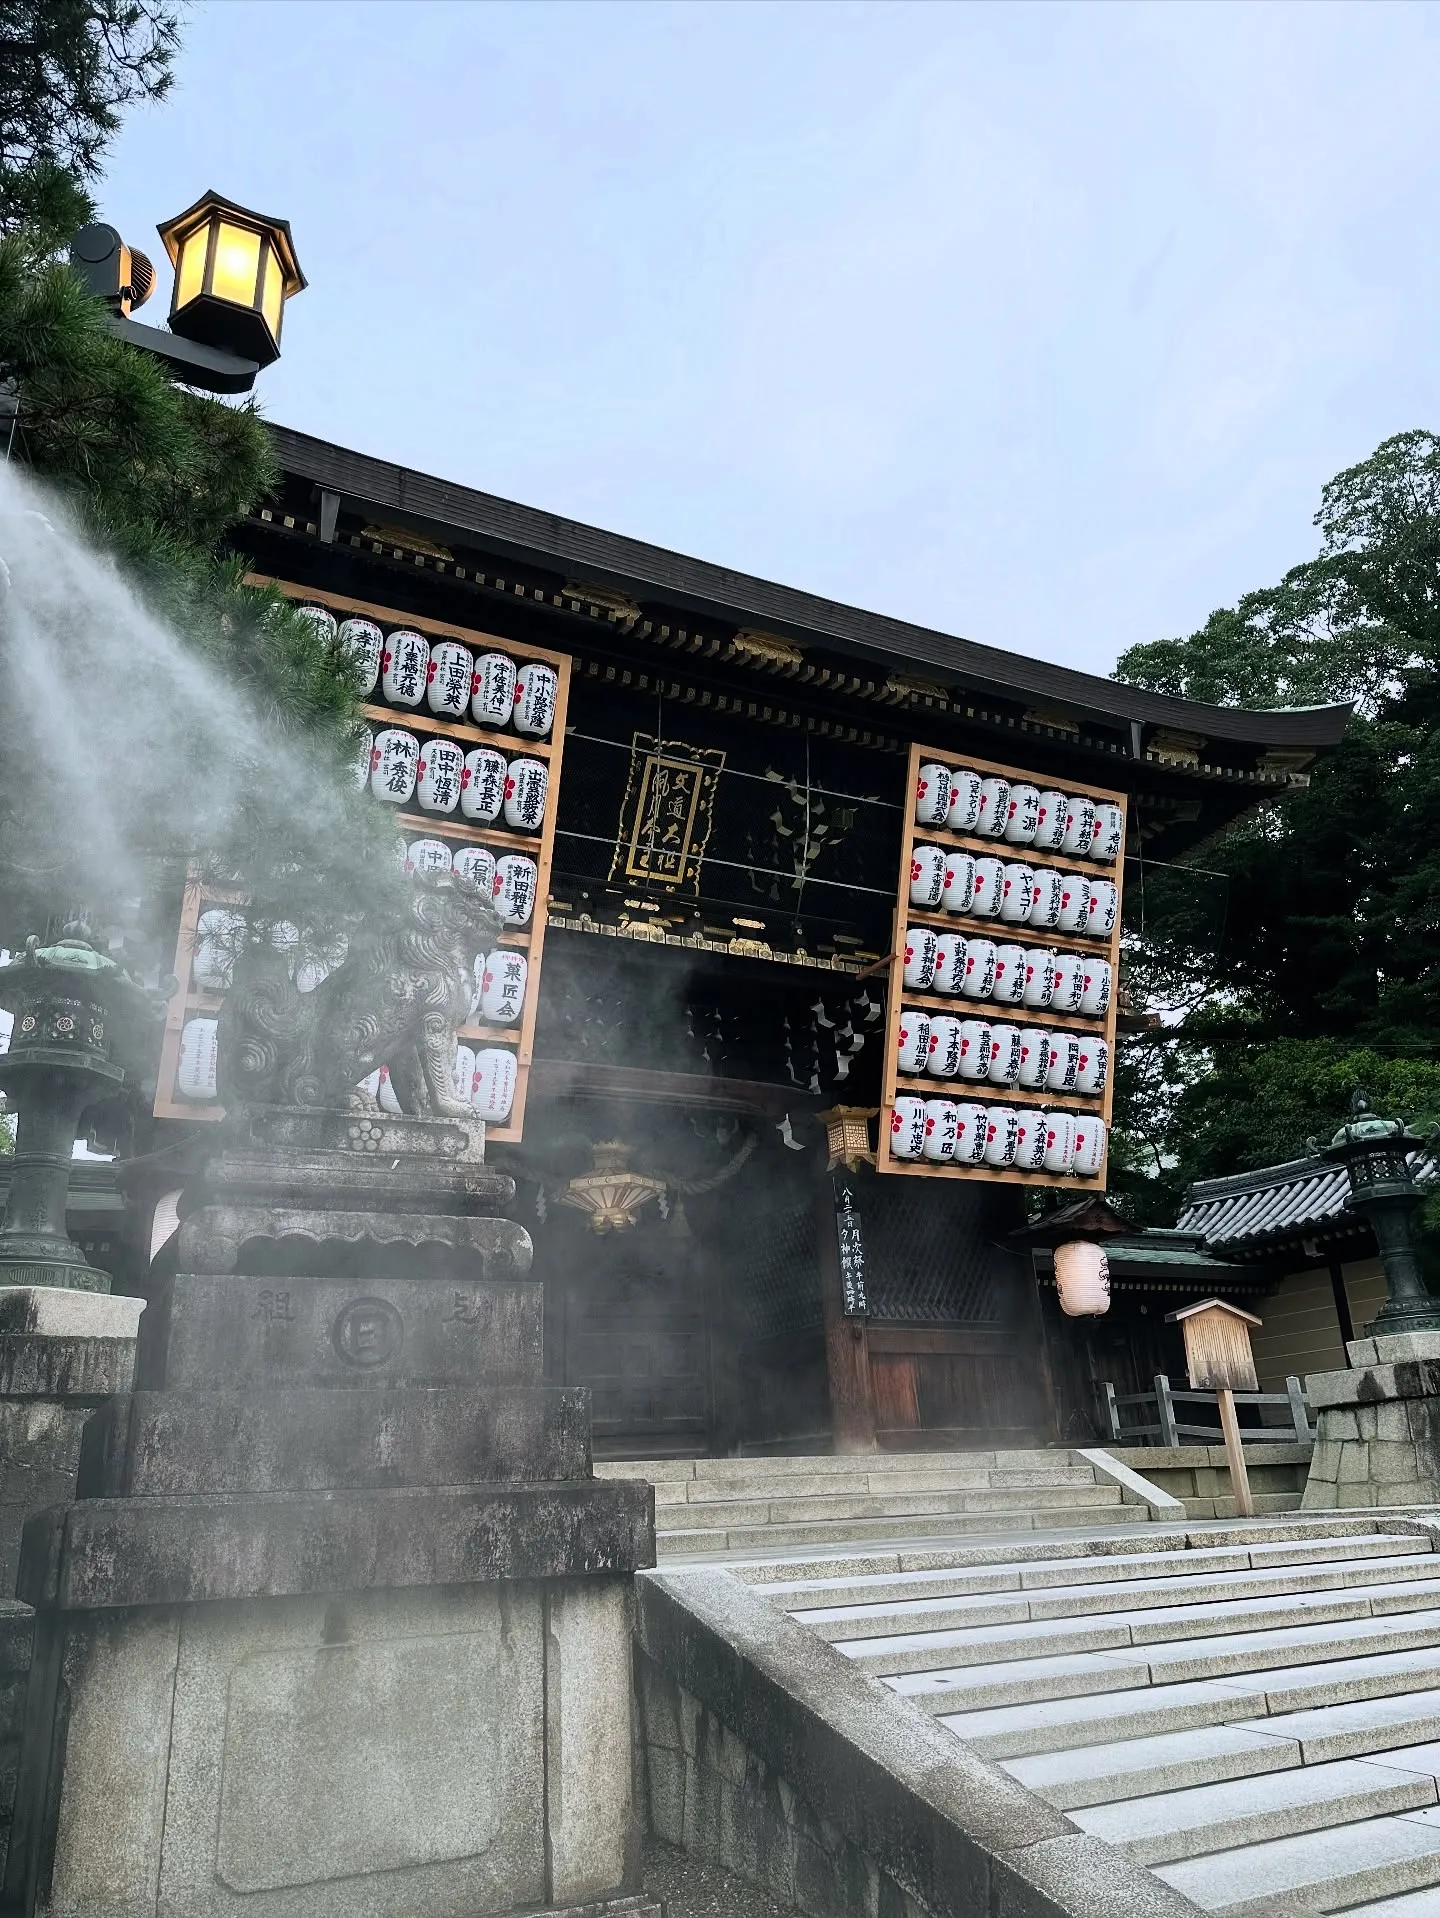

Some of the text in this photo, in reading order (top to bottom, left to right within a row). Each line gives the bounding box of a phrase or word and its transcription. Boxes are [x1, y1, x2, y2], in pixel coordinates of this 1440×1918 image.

[386, 740, 412, 794] 林秀俊
[476, 759, 500, 814] 藤森長正
[1022, 795, 1040, 832] 材源
[1074, 807, 1095, 850] 福井紙店
[1104, 831, 1121, 856] 老松
[508, 864, 532, 920] 新田雅美
[1019, 872, 1034, 916] ヤギコー
[496, 962, 523, 1018] 菓匠会
[1040, 965, 1054, 1004] 伊吹文明
[1066, 972, 1084, 1008] 初田和久
[914, 1023, 930, 1068] 稲田慎一郎
[908, 1108, 925, 1154] 川村忠史
[941, 1111, 957, 1155] 和乃匠
[969, 1114, 988, 1161] 竹内鮮魚店
